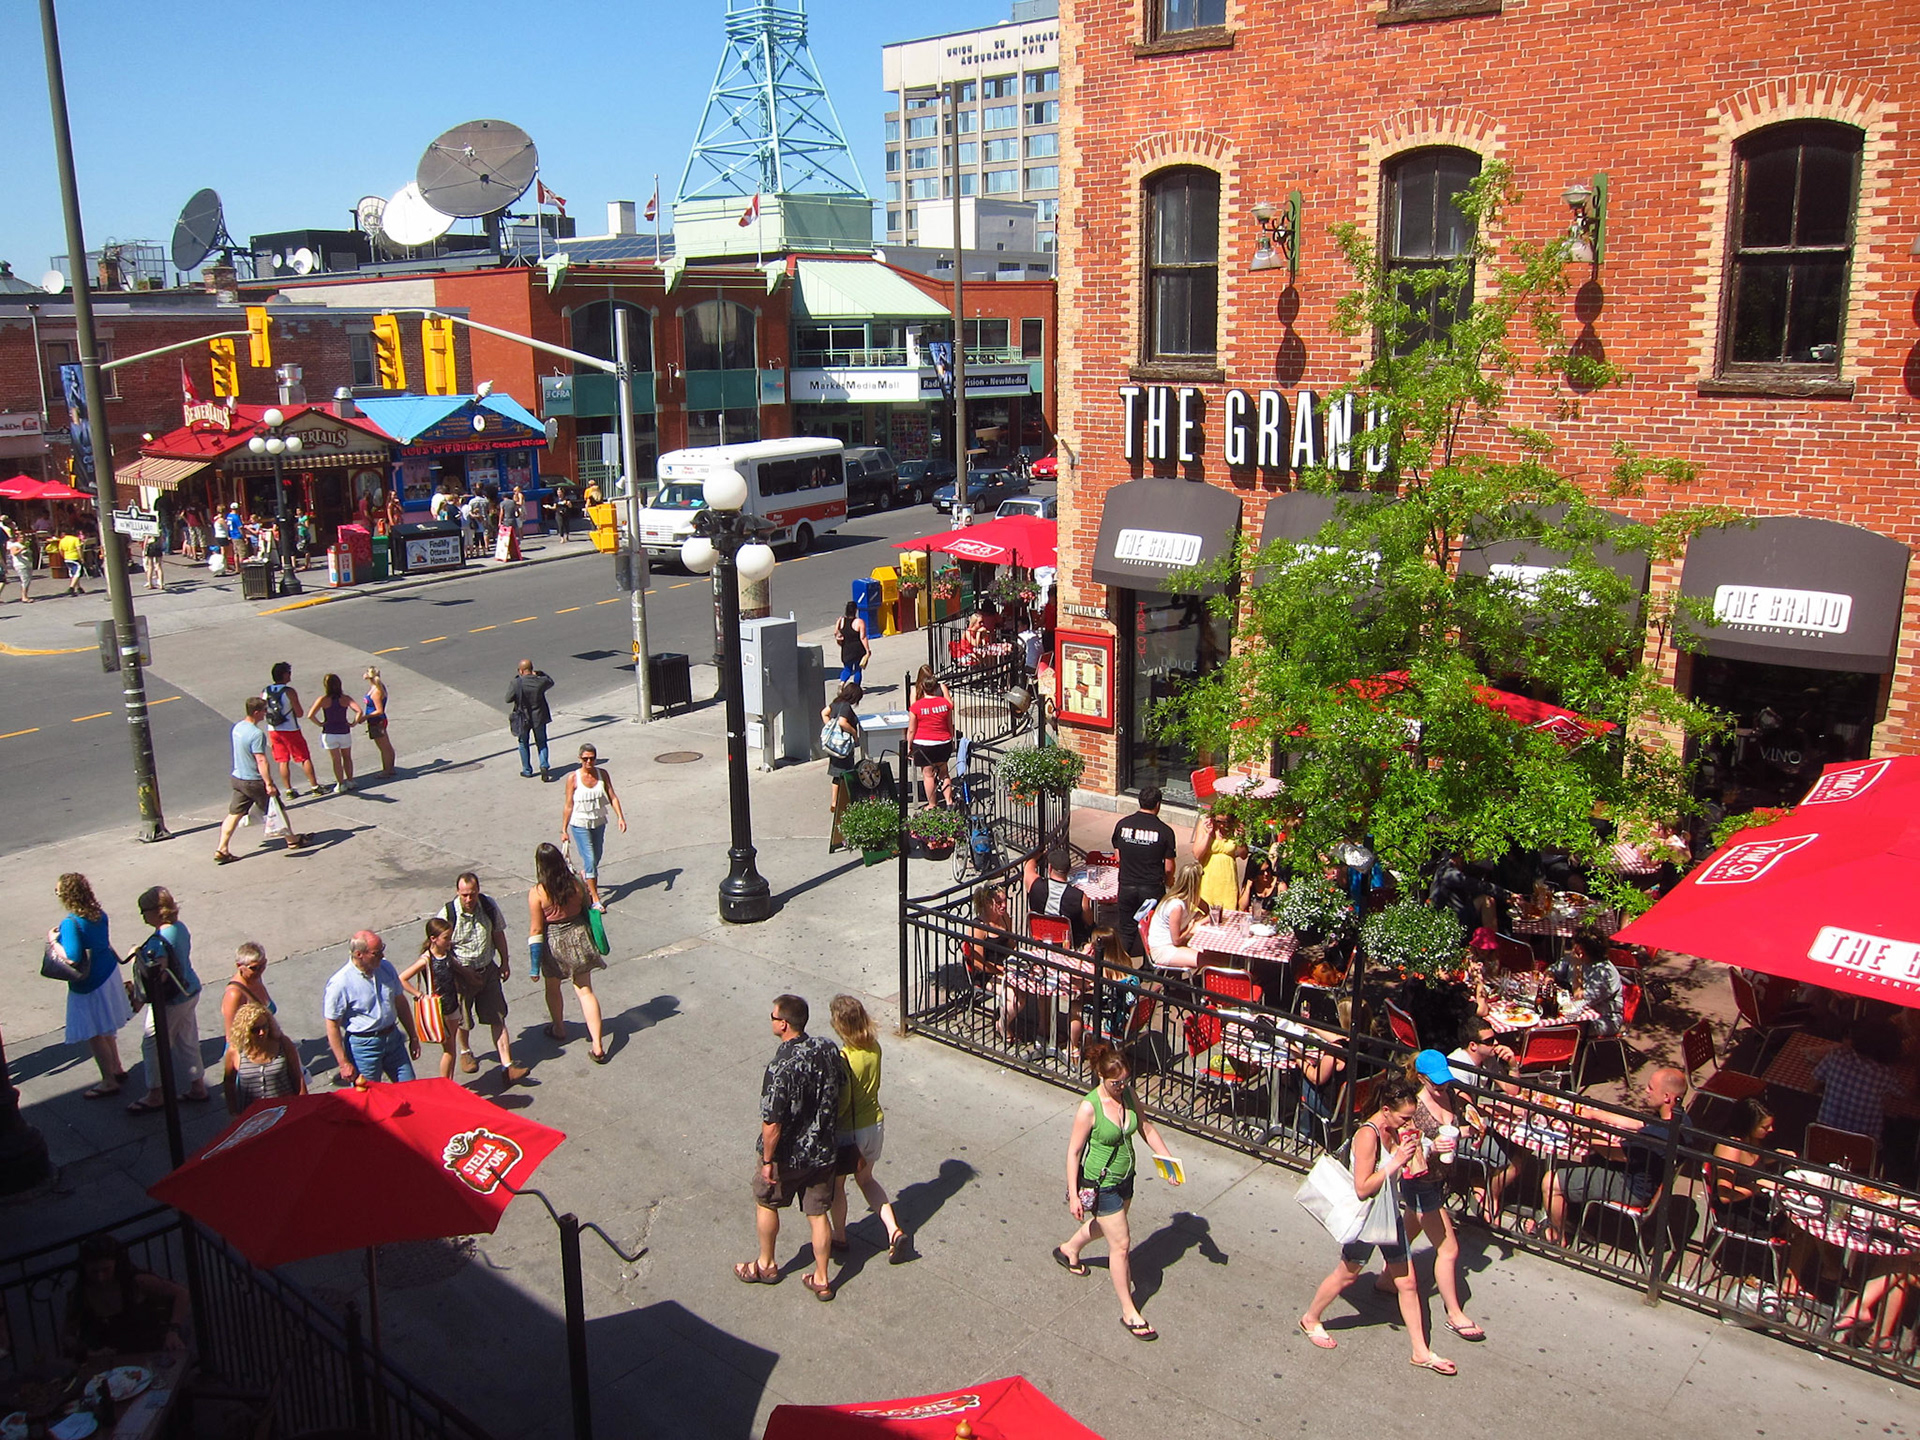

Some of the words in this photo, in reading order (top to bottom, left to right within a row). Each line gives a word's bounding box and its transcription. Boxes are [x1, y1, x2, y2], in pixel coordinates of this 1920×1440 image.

[1119, 386, 1194, 462] THE
[1224, 388, 1392, 474] GRAND
[1120, 534, 1145, 557] THE
[1148, 537, 1196, 562] GRAND
[1063, 604, 1097, 617] WILLIAM
[1722, 590, 1759, 620] THE
[1768, 594, 1844, 628] GRAND
[1727, 624, 1782, 635] PIZZERIA
[1788, 628, 1797, 636] &
[1801, 630, 1825, 640] BAR
[1160, 656, 1198, 673] DOLCE
[1760, 745, 1802, 765] VINO
[1826, 933, 1891, 971] THE
[1834, 967, 1920, 993] PIZZERIA
[463, 1143, 497, 1176] STELLA
[475, 1147, 509, 1184] ARTOIS
